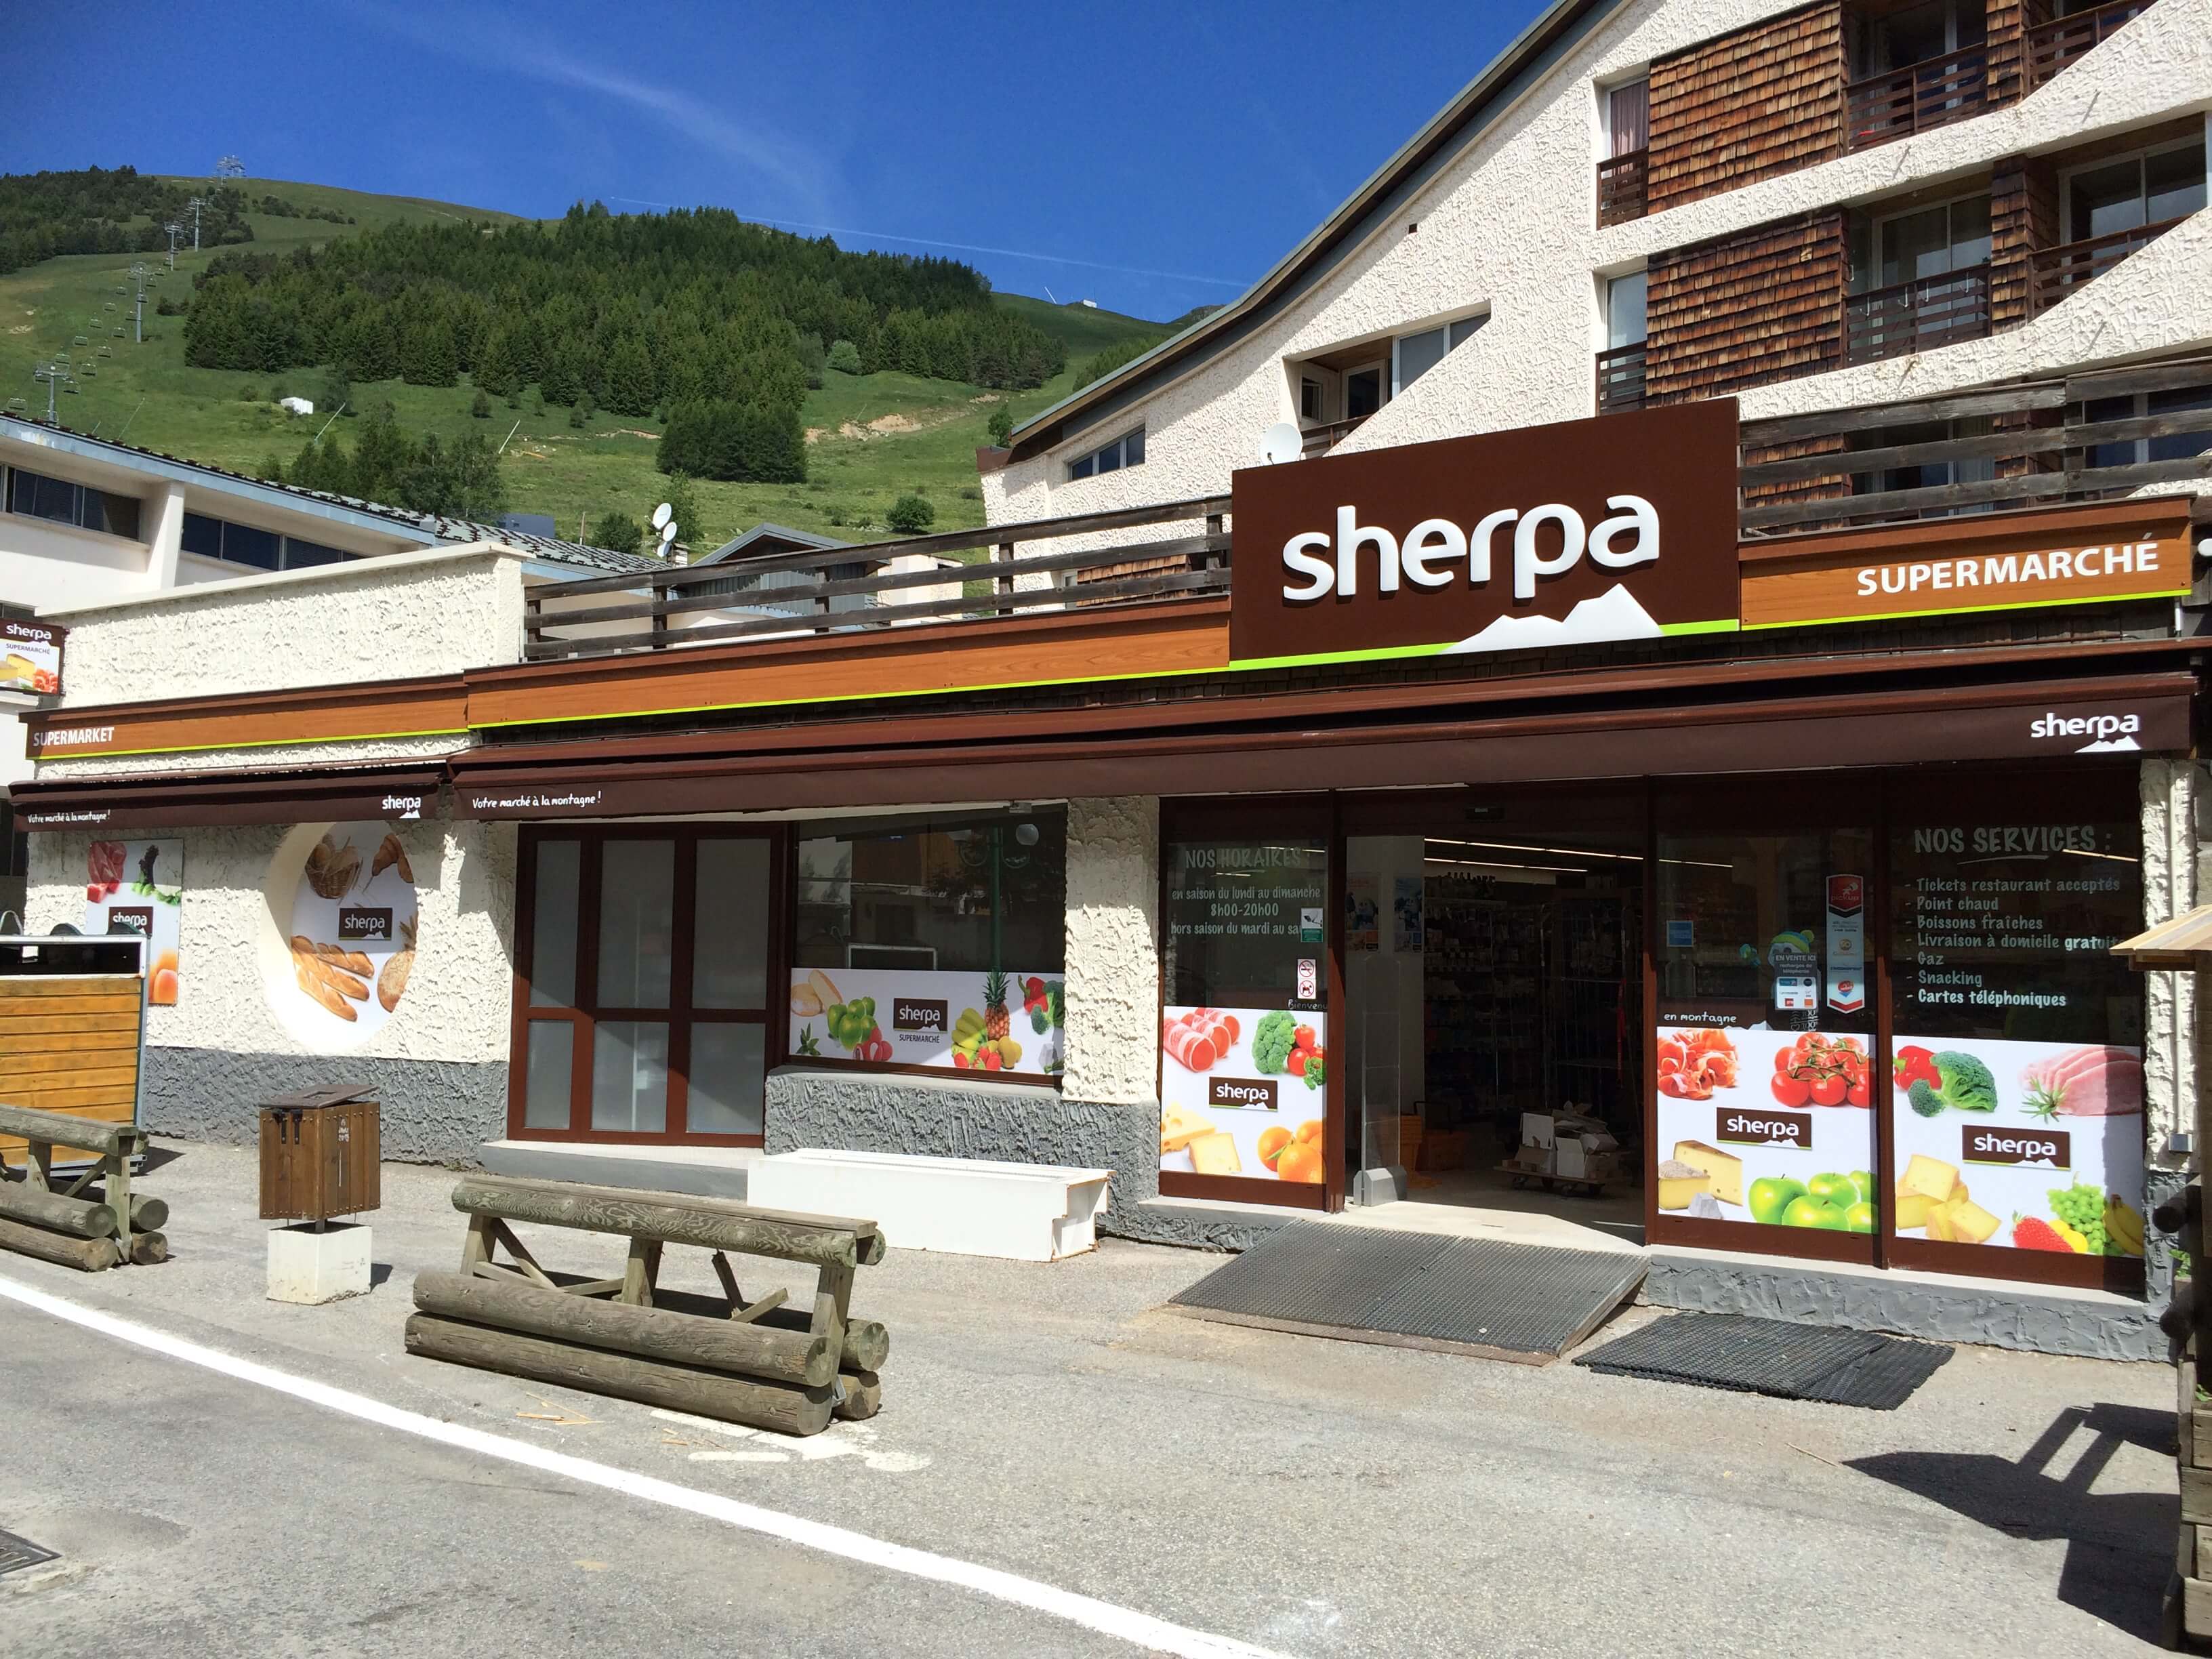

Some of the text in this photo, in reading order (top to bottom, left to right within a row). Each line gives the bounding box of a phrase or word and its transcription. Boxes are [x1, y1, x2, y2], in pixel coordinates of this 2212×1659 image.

[1282, 494, 1660, 600] sherpa
[1857, 532, 2160, 596] SUPERMARCHÉ
[6, 623, 52, 640] sherpa
[2030, 712, 2141, 739] sherpa
[33, 726, 115, 747] SUPERMARKET
[382, 796, 422, 812] sherpa
[472, 798, 497, 808] Votre
[499, 795, 531, 808] marché
[533, 795, 539, 806] à
[541, 795, 550, 806] la
[28, 814, 44, 823] Votre
[71, 812, 77, 822] la
[1914, 827, 1965, 854] NOS
[1973, 825, 2096, 853] SERVICES
[1186, 848, 1216, 868] NOS
[1216, 846, 1302, 868] HORAIRES
[1172, 884, 1321, 900] en saison du lundi au dimanche
[1917, 877, 2121, 894] Tickets restaurant acceptés
[1210, 902, 1279, 917] 8h00-20h00
[1917, 895, 1999, 911] Point chaud
[344, 914, 386, 932] sherpa
[1170, 921, 1191, 935] hors
[1194, 922, 1224, 935] saison
[1227, 921, 1238, 935] du
[1241, 921, 1270, 935] mardi
[1272, 923, 1284, 935] au
[1917, 913, 2044, 929] Boissons fraîches
[1917, 932, 1982, 947] Livraison
[1986, 933, 1996, 947] à
[2001, 933, 2060, 949] domicile
[1917, 951, 1944, 966] Gaz
[1918, 969, 1983, 987] Snacking
[1918, 987, 2067, 1009] Cartes téléphoniques
[899, 1004, 941, 1025] sherpa
[1664, 1010, 1737, 1025] en montagne
[1216, 1082, 1269, 1103] sherpa
[1726, 1115, 1800, 1139] sherpa
[1973, 1132, 2057, 1158] sherpa
